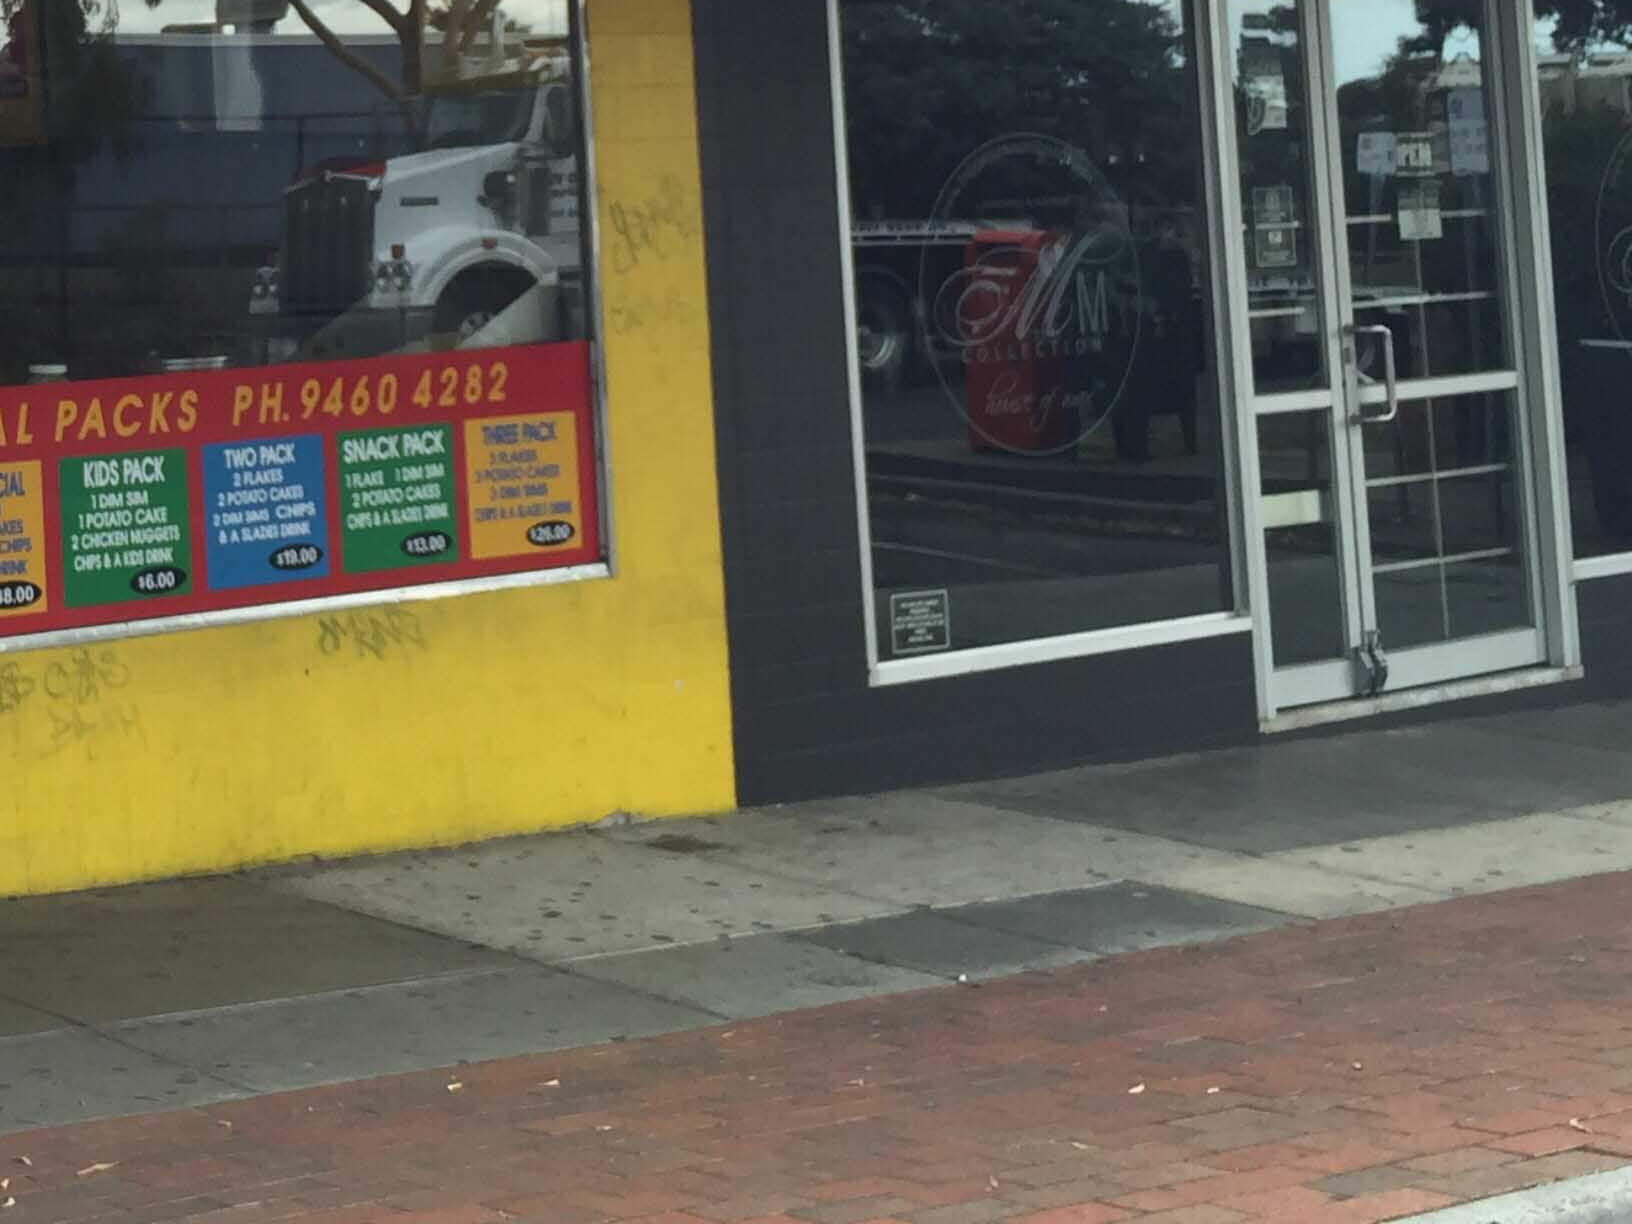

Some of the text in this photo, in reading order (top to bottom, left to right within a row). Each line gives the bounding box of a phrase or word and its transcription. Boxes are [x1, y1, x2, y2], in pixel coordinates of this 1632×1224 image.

[56, 389, 198, 441] PACKS
[233, 384, 290, 426] PH.
[300, 373, 398, 419] 9460
[414, 362, 509, 409] 4282
[481, 421, 556, 446] THREE PACK
[224, 443, 295, 469] TWO PACK
[344, 429, 445, 464] SNACK PACK
[83, 456, 165, 488] KIDS PACK
[243, 468, 284, 486] FLAKES
[352, 469, 385, 488] FLAKE
[402, 465, 423, 482] DIM
[91, 490, 148, 509] 1 DIM SIM
[227, 488, 268, 506] POTATO
[270, 484, 304, 501] CAKES
[362, 487, 404, 507] POTATO
[406, 483, 441, 502] CAKES
[78, 506, 167, 529] 1 POTATO CAKE
[222, 512, 243, 526] DIM
[275, 501, 316, 519] CHIPS
[71, 524, 180, 550] 2 CHICKEN NUGGETS
[230, 529, 239, 543] A
[280, 520, 311, 539] DRINK
[74, 553, 102, 572] CHIPS
[113, 552, 122, 568] A
[124, 550, 144, 567] KIDS
[146, 547, 173, 564] DRINK
[138, 571, 175, 591] $6.00
